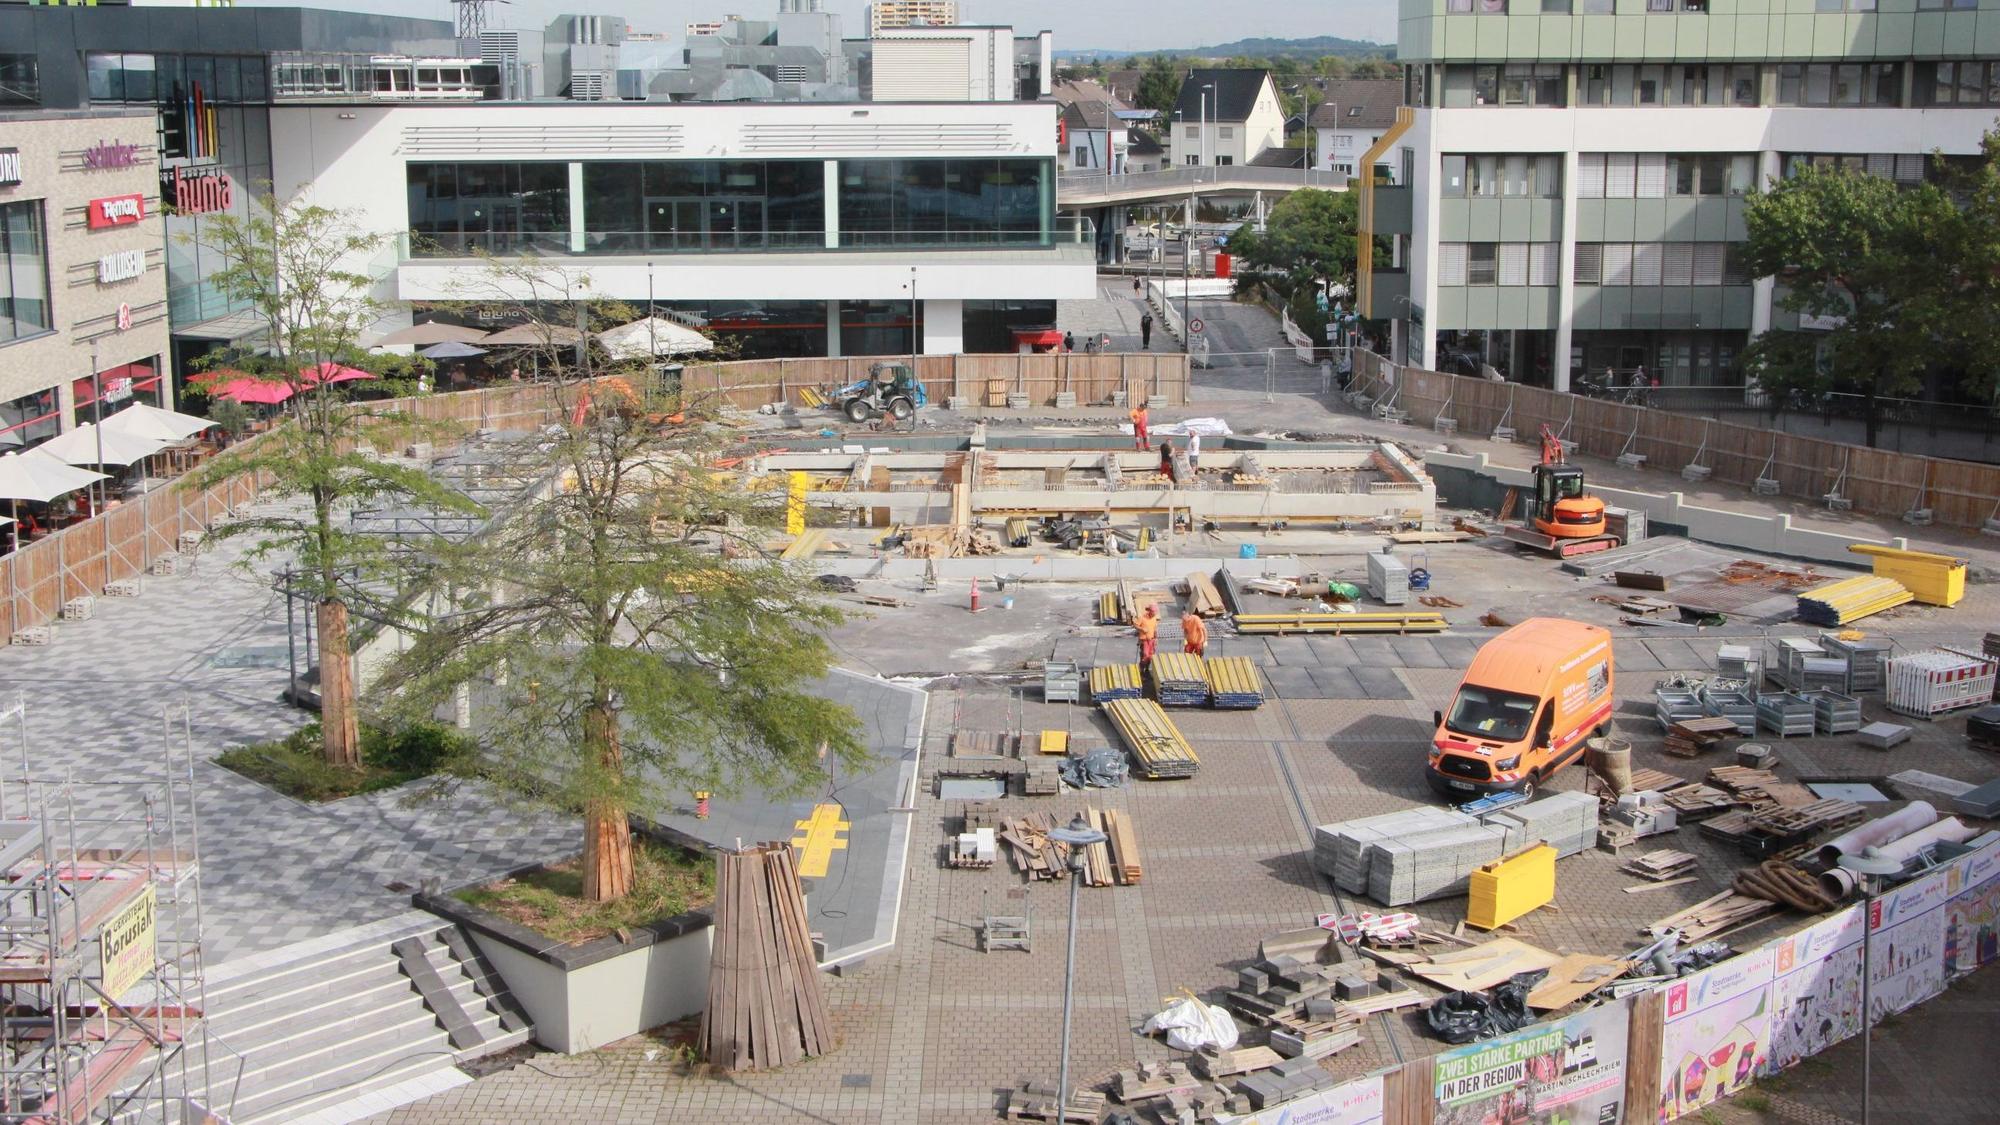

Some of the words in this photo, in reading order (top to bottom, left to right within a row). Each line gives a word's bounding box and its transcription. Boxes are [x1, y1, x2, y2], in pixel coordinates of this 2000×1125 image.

[175, 164, 233, 217] huma
[105, 896, 153, 964] Borusiak
[1439, 1061, 1467, 1081] ZWEI
[1470, 1047, 1512, 1071] STARKE
[1514, 1032, 1563, 1060] PARTNER
[1568, 1059, 1622, 1084] SCHLECHTRIEM
[1442, 1083, 1454, 1100] IN
[1458, 1076, 1480, 1095] DER
[1483, 1063, 1523, 1088] REGION
[1291, 1105, 1335, 1125] Stadtwerke
